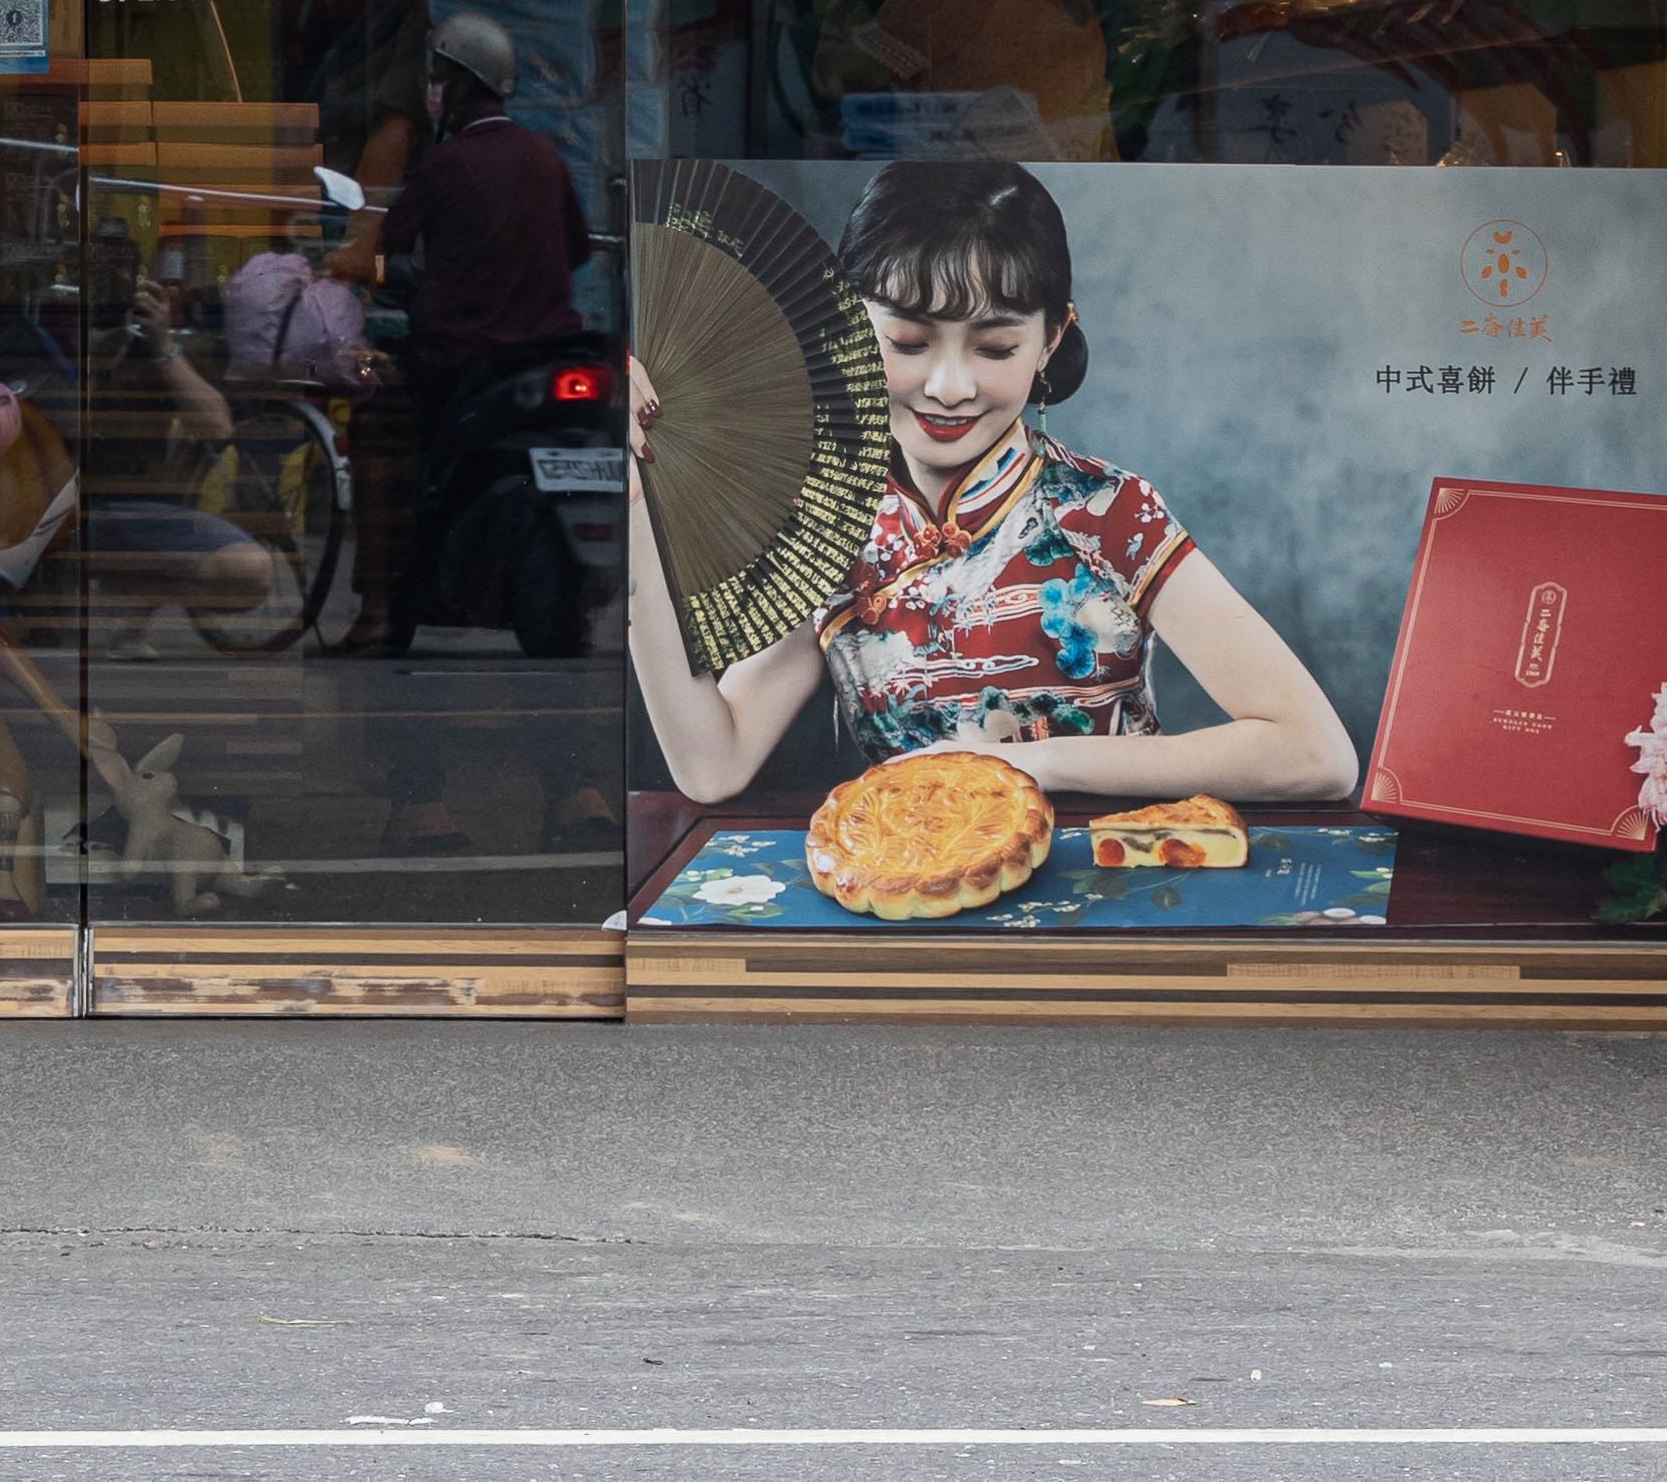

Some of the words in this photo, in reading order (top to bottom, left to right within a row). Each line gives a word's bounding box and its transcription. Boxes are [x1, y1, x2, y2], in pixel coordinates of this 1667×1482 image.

[1376, 364, 1497, 395] 中式喜餅
[1545, 365, 1638, 396] 伴手禮
